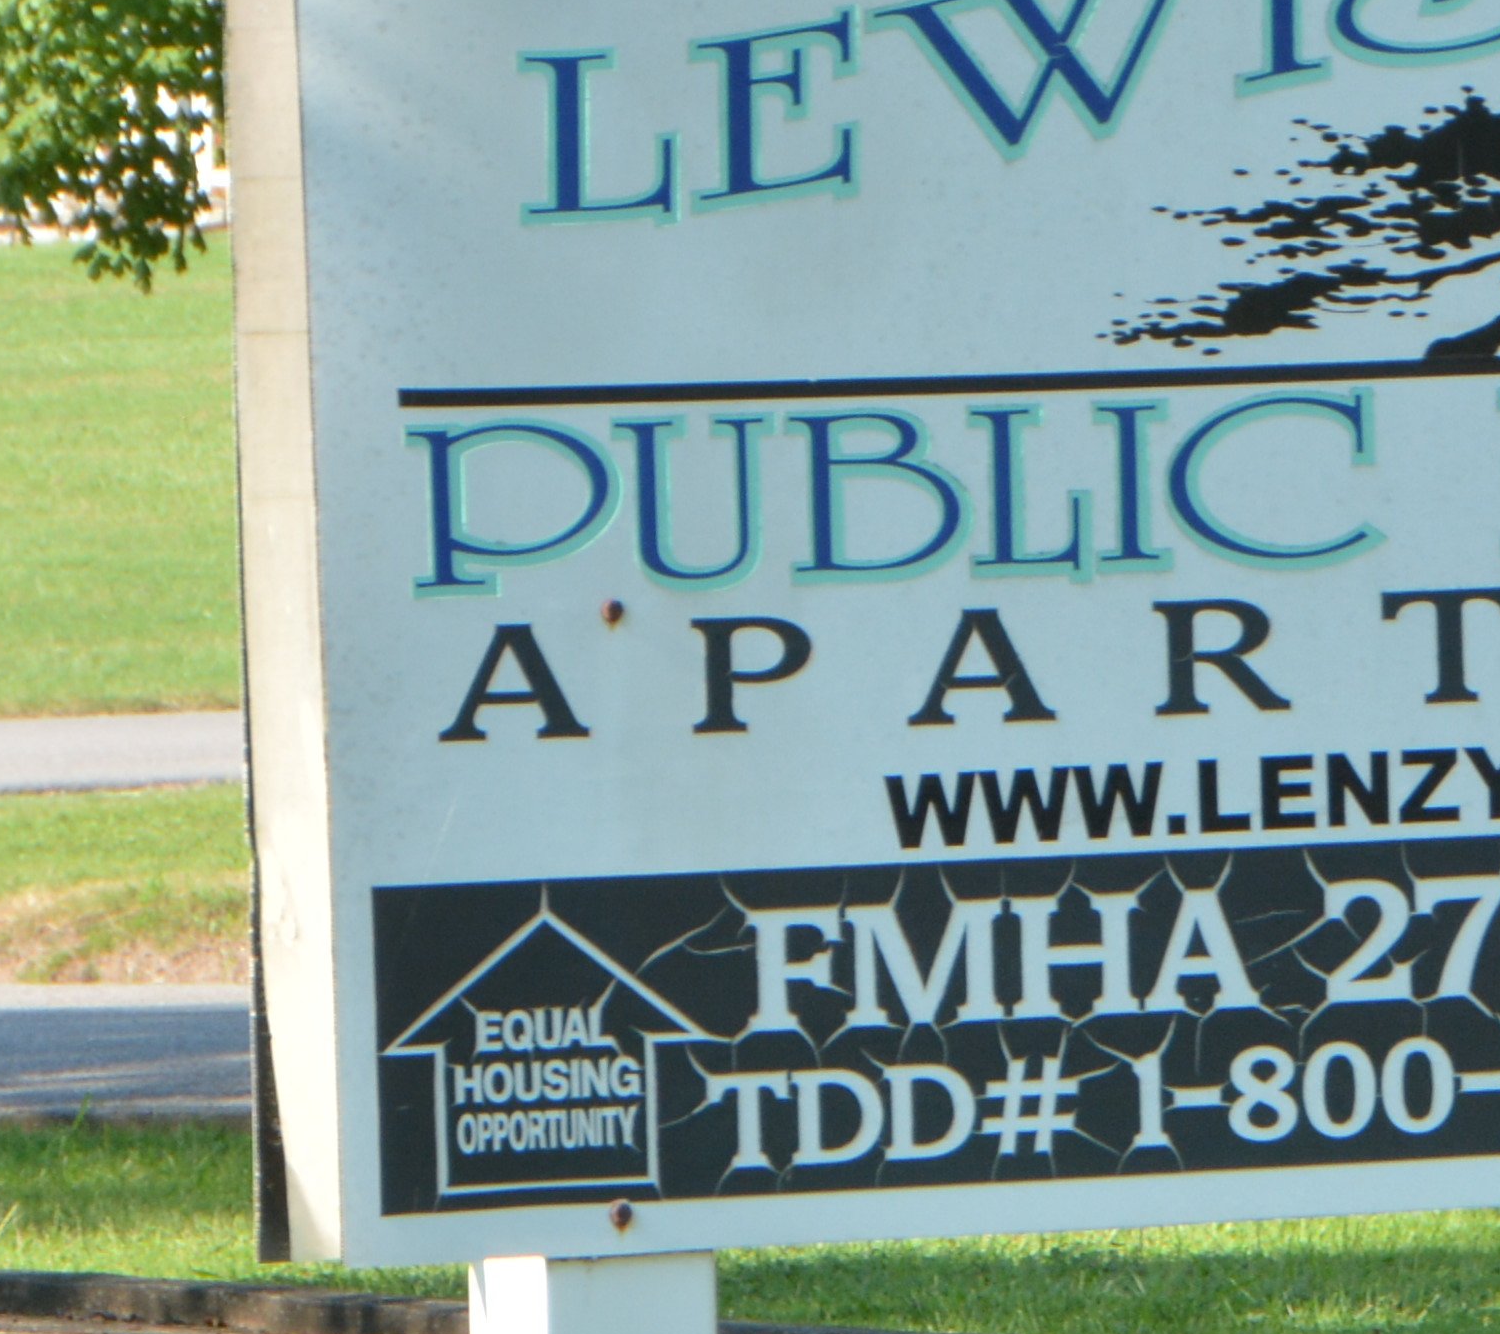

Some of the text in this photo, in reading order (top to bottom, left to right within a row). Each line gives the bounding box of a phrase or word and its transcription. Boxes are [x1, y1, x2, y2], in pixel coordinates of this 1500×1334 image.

[404, 386, 1387, 598] PUBLIC
[744, 889, 1262, 1031] FMHA
[475, 1007, 616, 1054] EQUAL
[453, 1055, 644, 1105] HOUSING
[708, 1057, 1078, 1169] TDD#
[457, 1104, 638, 1155] OPPORTUNITY
